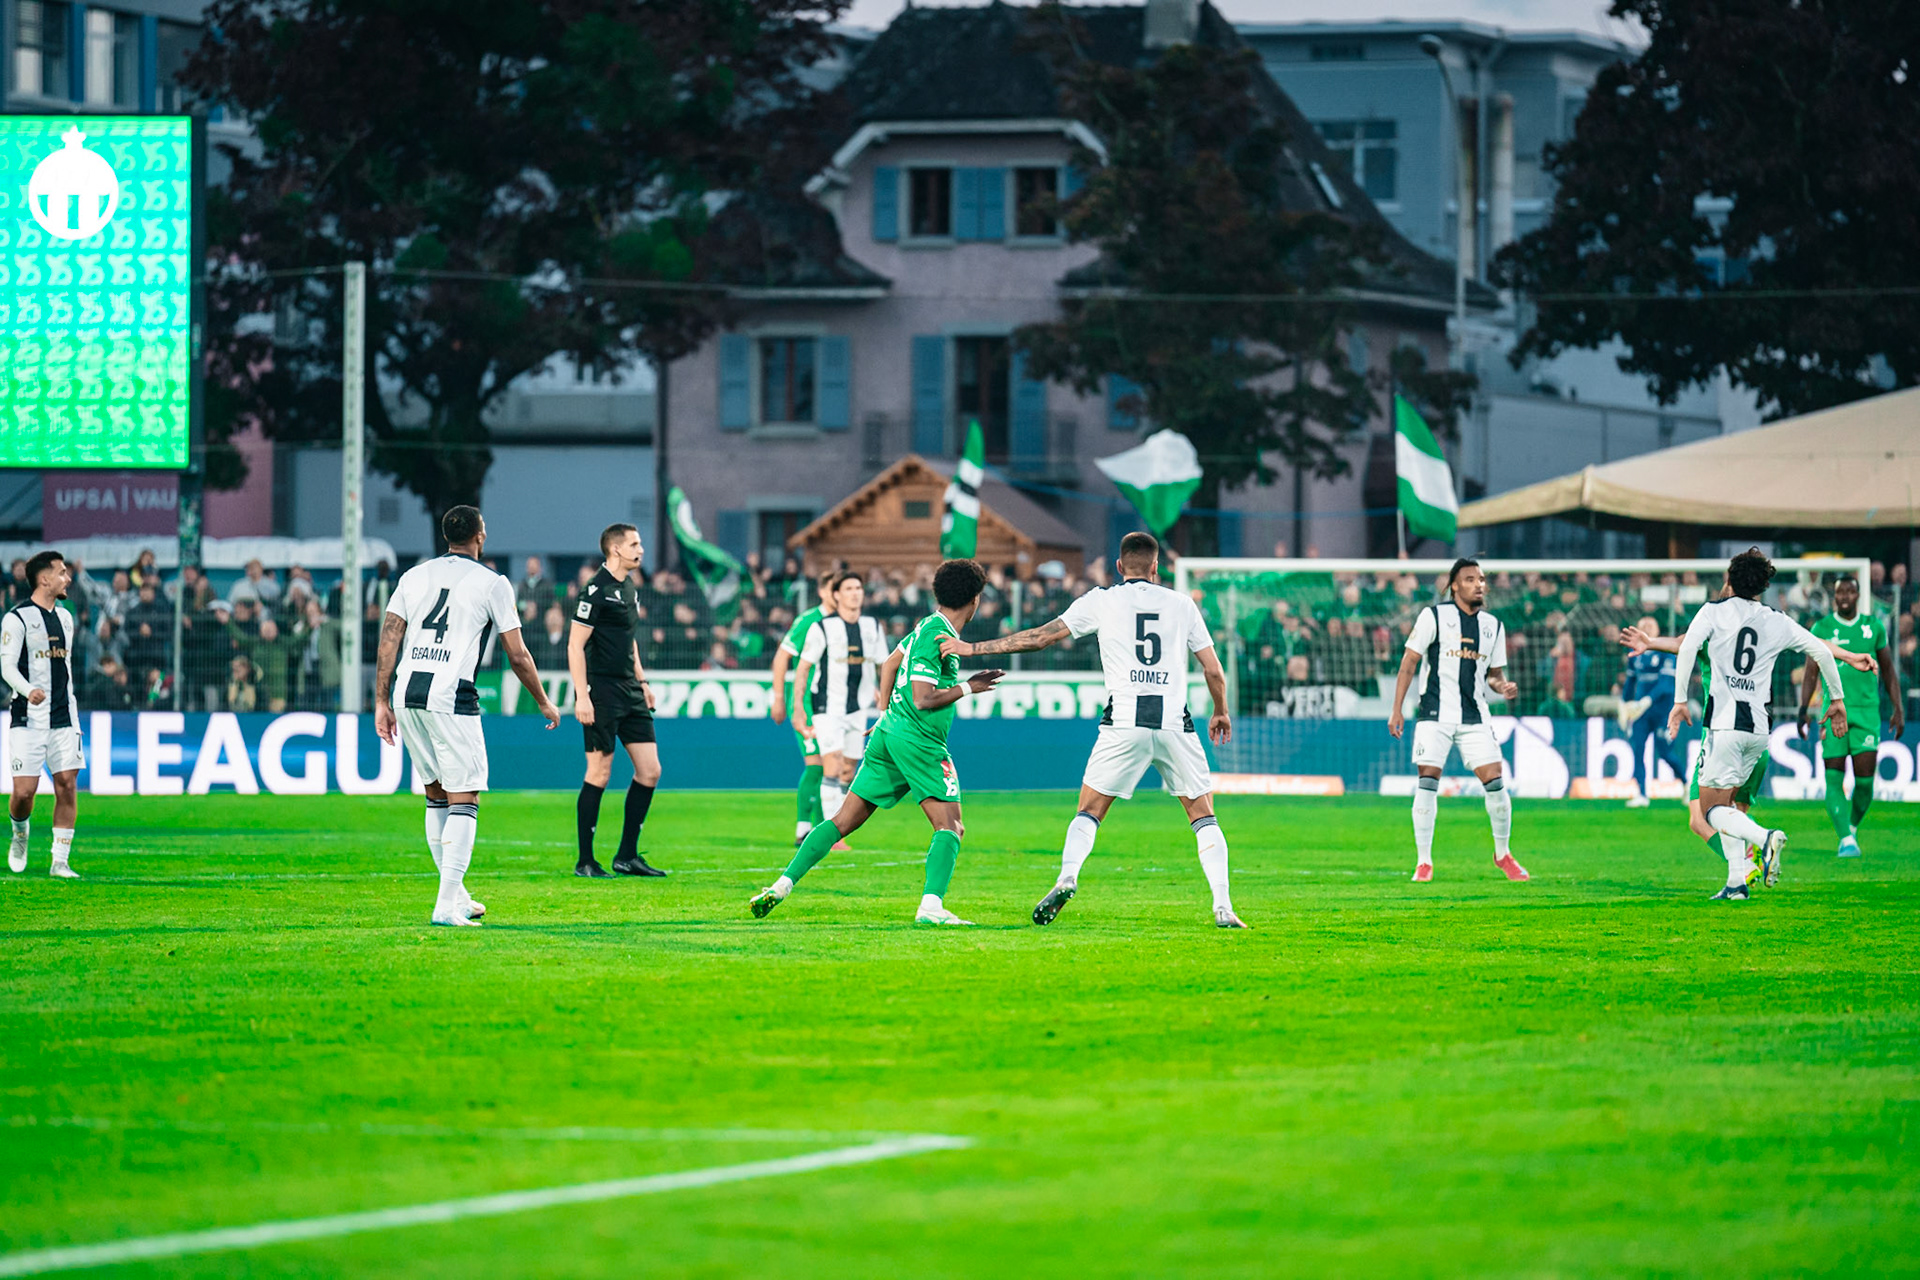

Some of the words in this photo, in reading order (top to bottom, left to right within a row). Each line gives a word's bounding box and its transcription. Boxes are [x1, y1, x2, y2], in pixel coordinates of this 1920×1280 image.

[55, 488, 116, 511] UPSA
[421, 588, 450, 644] 4
[1135, 613, 1162, 666] 5
[1733, 626, 1759, 676] 6
[1130, 669, 1169, 685] GOMEZ
[1725, 675, 1756, 692] TSAWA
[90, 711, 427, 795] LEAGU
